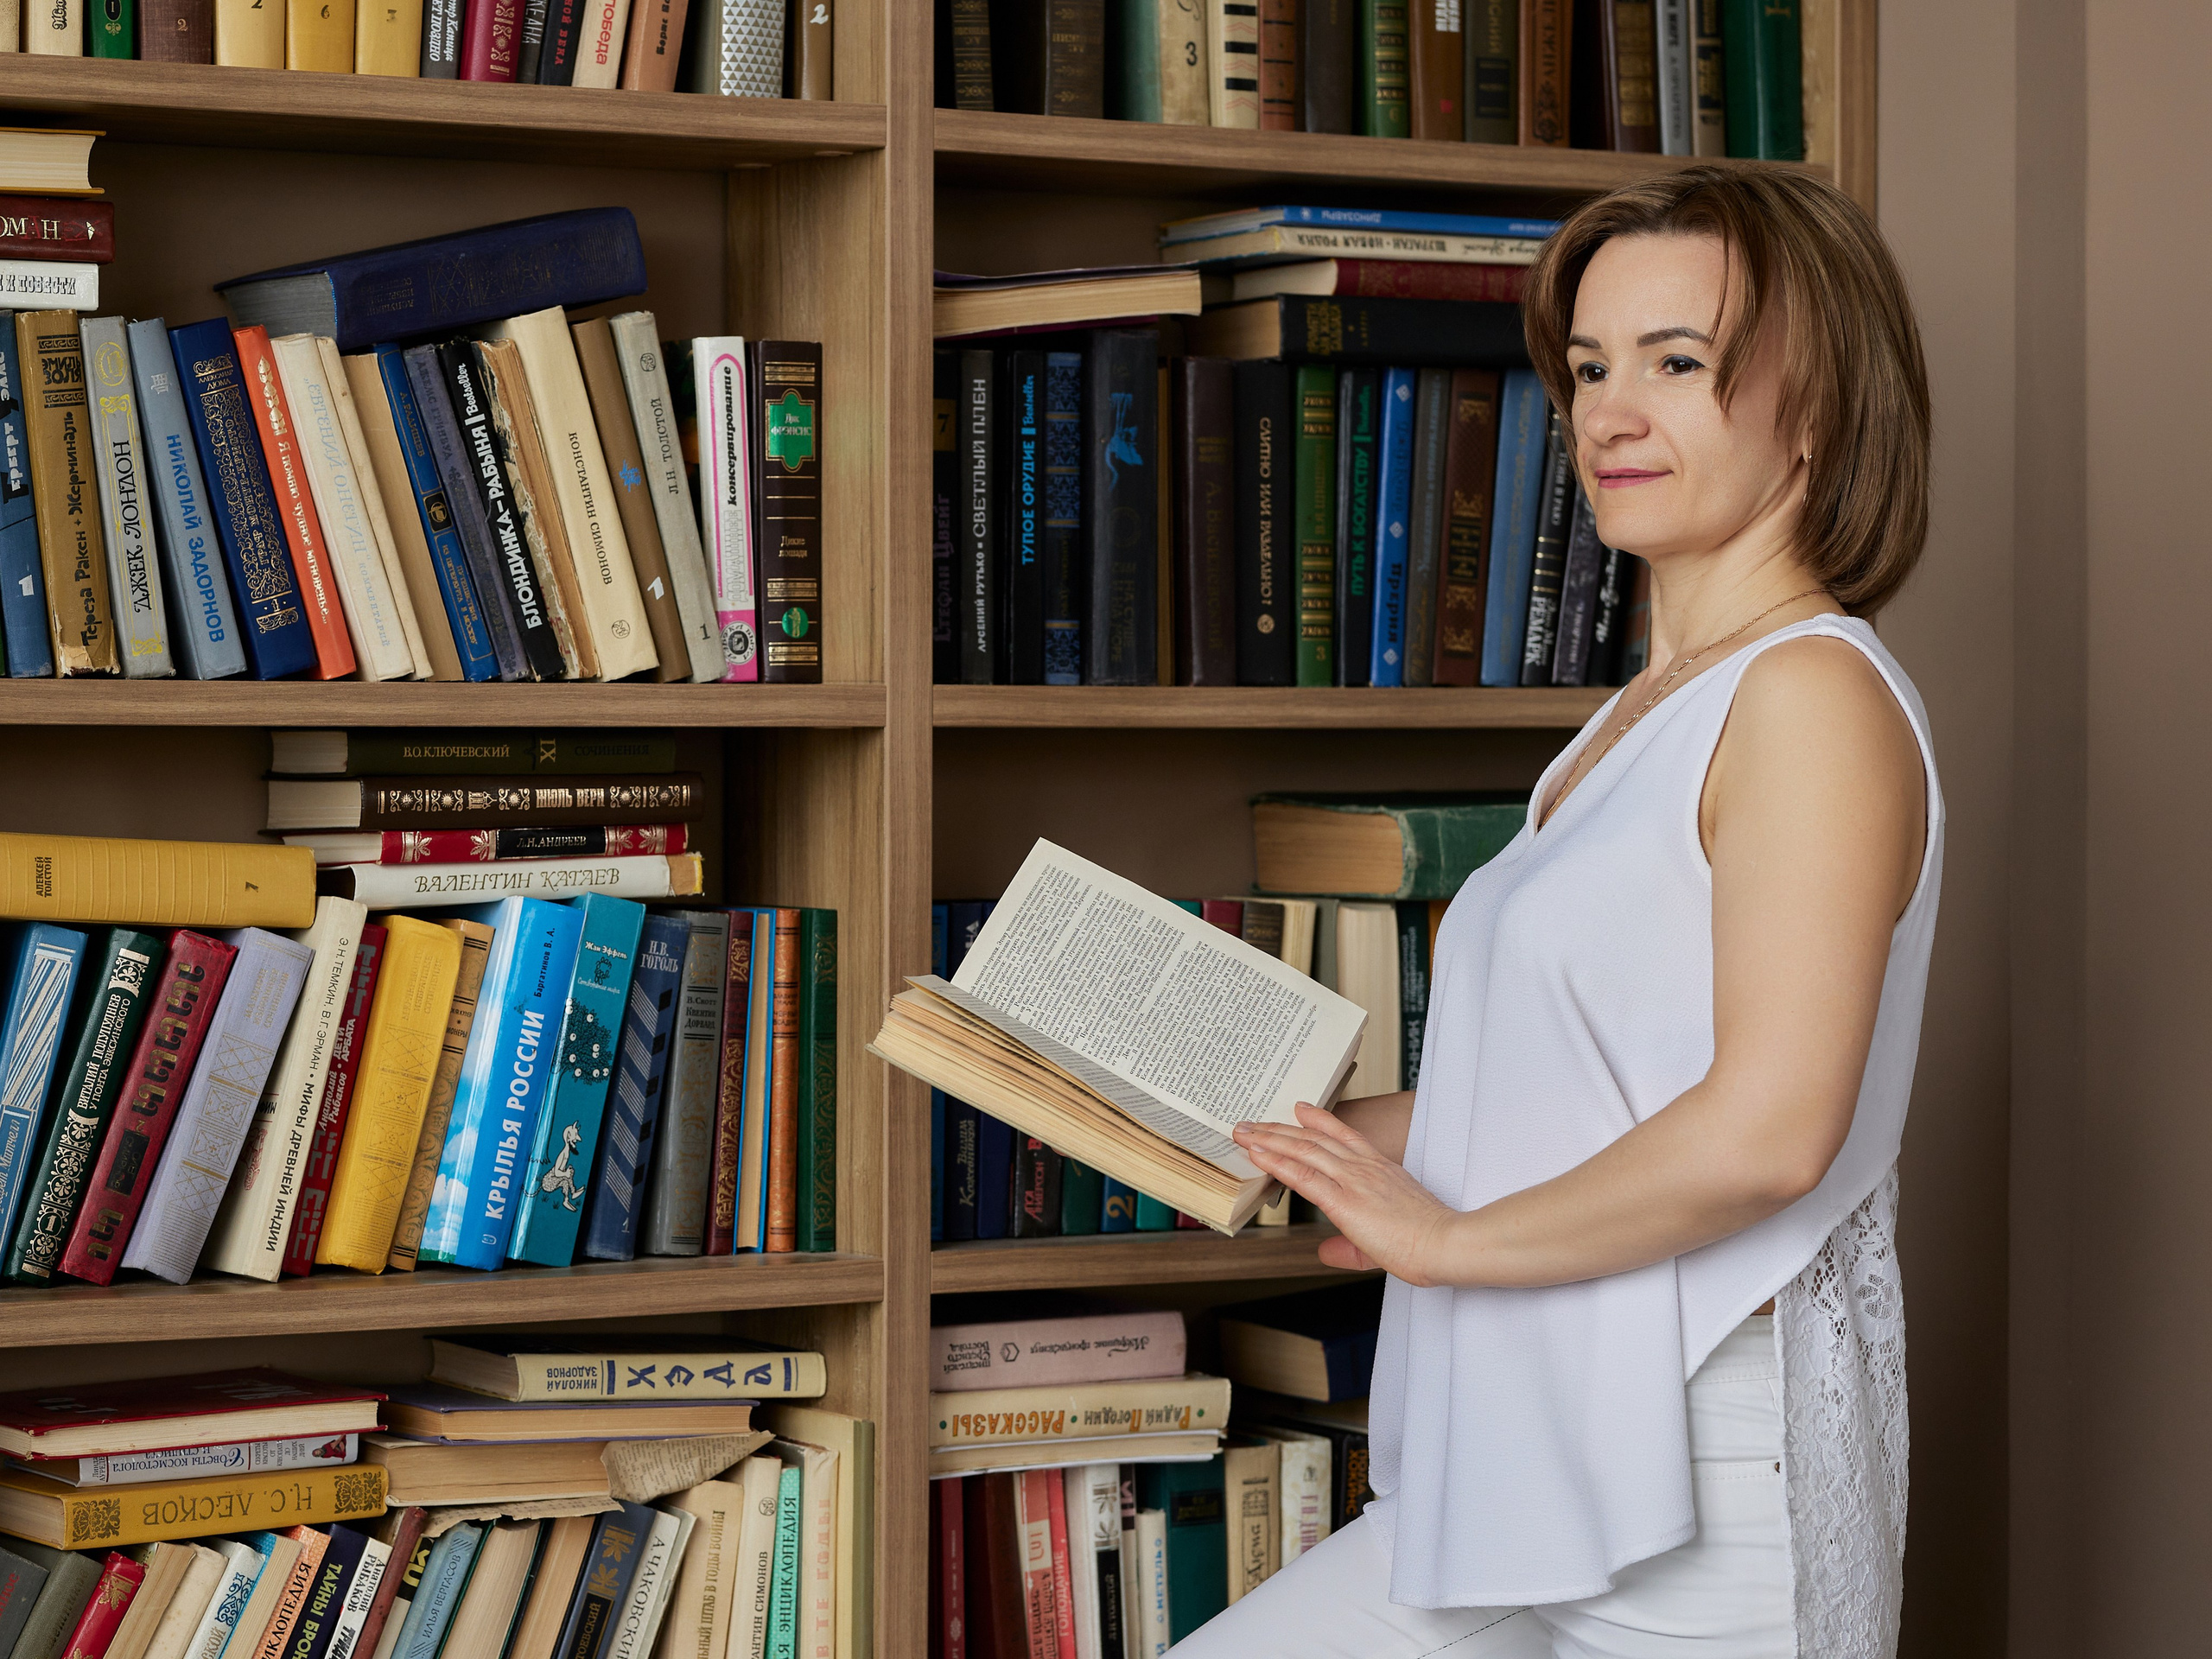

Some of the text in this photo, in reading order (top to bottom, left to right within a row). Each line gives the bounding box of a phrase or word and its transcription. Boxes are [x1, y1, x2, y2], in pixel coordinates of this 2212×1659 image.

[177, 18, 188, 31] 2
[321, 3, 331, 19] 6
[809, 3, 830, 25] 2
[429, 14, 442, 61] ПОЗДНО
[443, 17, 459, 61] Капица
[554, 29, 568, 65] ВЕКА
[1185, 41, 1198, 67] 3
[1343, 234, 1384, 250] НОВАЯ
[6, 274, 77, 296] И ПОВЕСТИ
[41, 355, 82, 372] ЭМИЛЬ
[44, 368, 84, 386] ЗОЛЯ
[198, 368, 234, 385] АЛЕКСАНДР
[207, 377, 232, 391] ДЮМА
[456, 362, 480, 416] Bestseller
[400, 391, 426, 458] А. РАДИЩЕВ
[430, 412, 453, 461] ГРИНВУД
[649, 397, 674, 463] ТОЛСТОЙ
[723, 365, 739, 507] консервирование
[771, 424, 814, 437] ФРЭНСИС
[784, 412, 801, 425] Дик
[278, 441, 291, 452] Я
[282, 454, 301, 498] помню
[1022, 374, 1036, 566] ТУПОЕ ОРУДИЕ Bestseller
[63, 411, 105, 646] Тереза Ракен Жерминаль
[113, 440, 152, 613] ДЖЕК ЛОНДОН
[295, 500, 313, 548] чудное
[568, 432, 613, 585] КОНСТАНТИН СИМОНОВ
[972, 378, 987, 653] АРСЕНИЙ РУТЬКО СВЕТЛЫЙ ПЛЕН
[1259, 416, 1273, 605] СЛИТНО ИЛИ РАЗДЕЛЬНО?
[1351, 447, 1370, 596] ПУТЬ К БОГАТСТВУ
[166, 433, 225, 643] НИКОЛАЙ ЗАДОРНОВ
[724, 509, 747, 604] ДОМАШНЕЕ
[779, 547, 810, 561] лошади
[780, 534, 807, 549] Дикие
[270, 598, 280, 613] 1
[359, 562, 391, 647] КОММЕНТАРИЙ
[699, 624, 712, 642] 1
[574, 743, 650, 757] СОЧИНЕНИЯ
[536, 787, 605, 809] ЖЮЛЬ ВЕРН
[35, 855, 44, 897] АЛЕКСЕЙ
[44, 855, 54, 899] ТОЛСТОЙ
[413, 868, 621, 894] ВАЛЕНТИН КАТАЕВ
[533, 948, 552, 998] Баргатинов
[548, 927, 556, 938] А.
[585, 941, 627, 961] Жан Эффель
[639, 954, 679, 973] ГОГОЛЬ
[77, 994, 122, 1112] ВИТАЛИЙ ПОЛУПУДНЕВ
[89, 997, 132, 1112] У ПОНТА ЭВКСИНСКОГО
[311, 1028, 327, 1071] ЭРМАН
[334, 1027, 346, 1058] ДЕТИ
[341, 1018, 356, 1063] АРБАТА
[299, 1083, 316, 1125] МИФЫ
[319, 1070, 339, 1132] Анатолий
[328, 1071, 347, 1124] Рыбаков
[485, 1009, 546, 1221] КРЫЛЬЯ РОССИИ
[284, 1127, 309, 1196] ДРЕВНЕЙ
[959, 1118, 976, 1207] Кожевников
[46, 1214, 56, 1231] 1
[265, 1198, 288, 1252] ИНДИИ
[620, 1219, 630, 1234] 1
[545, 1365, 598, 1378] ЗАДОРНОВ
[546, 1379, 597, 1391] НИКОЛАЙ
[951, 1410, 1065, 1437] РАССКАЗЫ
[112, 1457, 188, 1474] косметолога
[191, 1447, 245, 1469] Советы
[1346, 1448, 1357, 1516] ХОКИНС
[142, 1489, 253, 1526] ЛЕСКОВ
[347, 1554, 378, 1612] РЫБАКОВ
[359, 1559, 386, 1614] Анатолий
[702, 1510, 727, 1626] ШТАБ В ГОДЫ ВОЙНЫ
[755, 1551, 769, 1612] СИМОНОВ
[779, 1496, 797, 1633] ЭНЦИКЛОПЕДИЯ
[1154, 1550, 1166, 1610] МЕТЕЛЬ
[311, 1562, 343, 1618] ТАЙНЫ
[422, 1554, 461, 1638] ИЛЬЯ ВЕРГАСОВ
[1053, 1550, 1071, 1637] ГОЛОДАНИЕ
